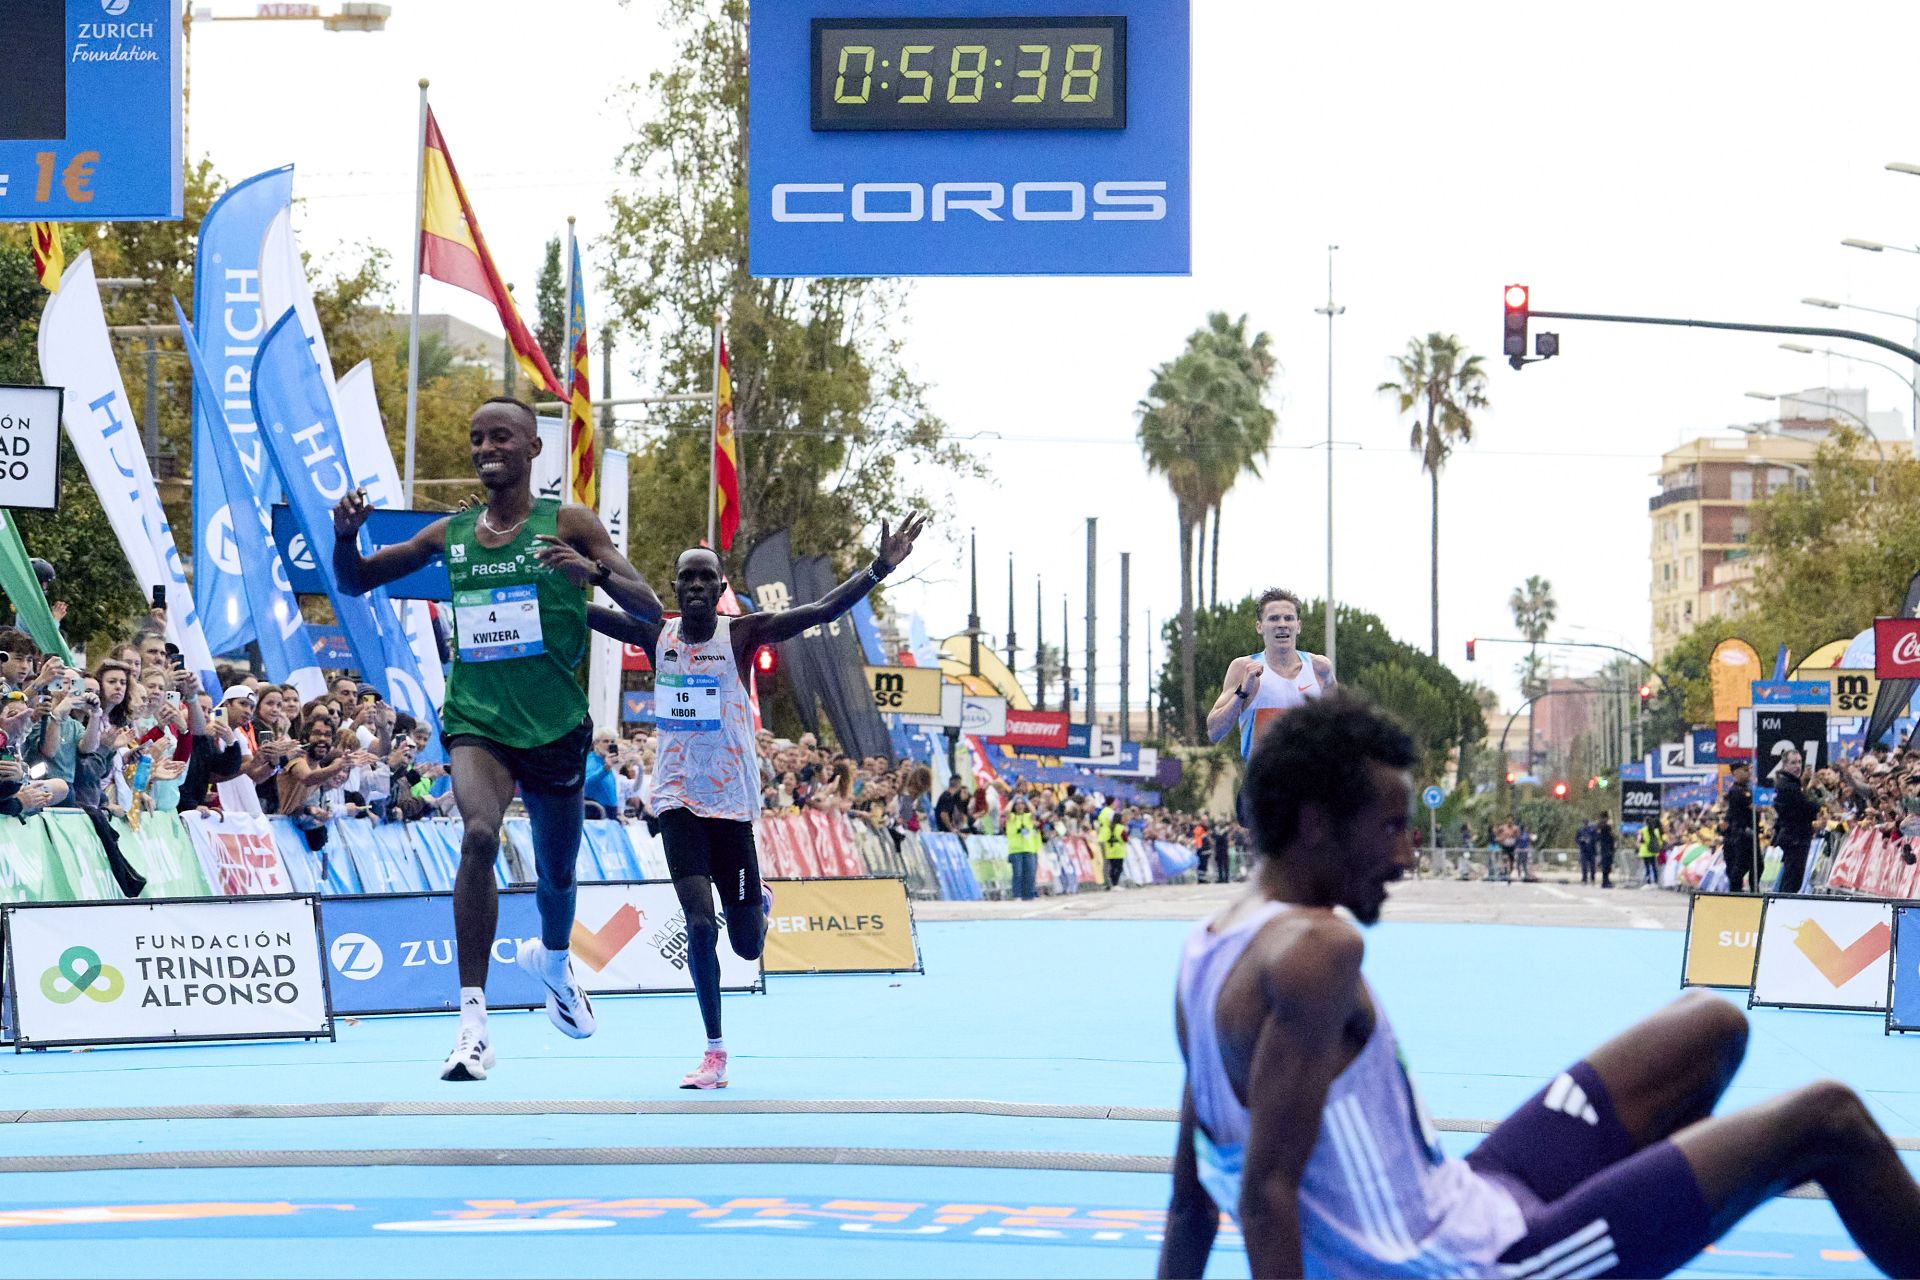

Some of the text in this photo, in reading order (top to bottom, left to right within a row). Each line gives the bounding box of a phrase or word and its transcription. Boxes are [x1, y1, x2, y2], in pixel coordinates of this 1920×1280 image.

[78, 23, 153, 39] ZURICH
[72, 44, 159, 63] Foundation
[834, 45, 1102, 103] 0:58:38
[771, 181, 1167, 222] COROS
[488, 611, 497, 623] 4
[473, 630, 520, 644] KWIZERA
[676, 692, 689, 702] 16
[671, 708, 696, 718] KIBOR
[1013, 721, 1062, 736] ENERVIT
[1762, 718, 1781, 730] KM
[767, 915, 884, 933] PERHALFS
[135, 931, 291, 950] FUNDACIÓN
[136, 954, 296, 980] TRINIDAD
[141, 981, 299, 1008] ALFONSO
